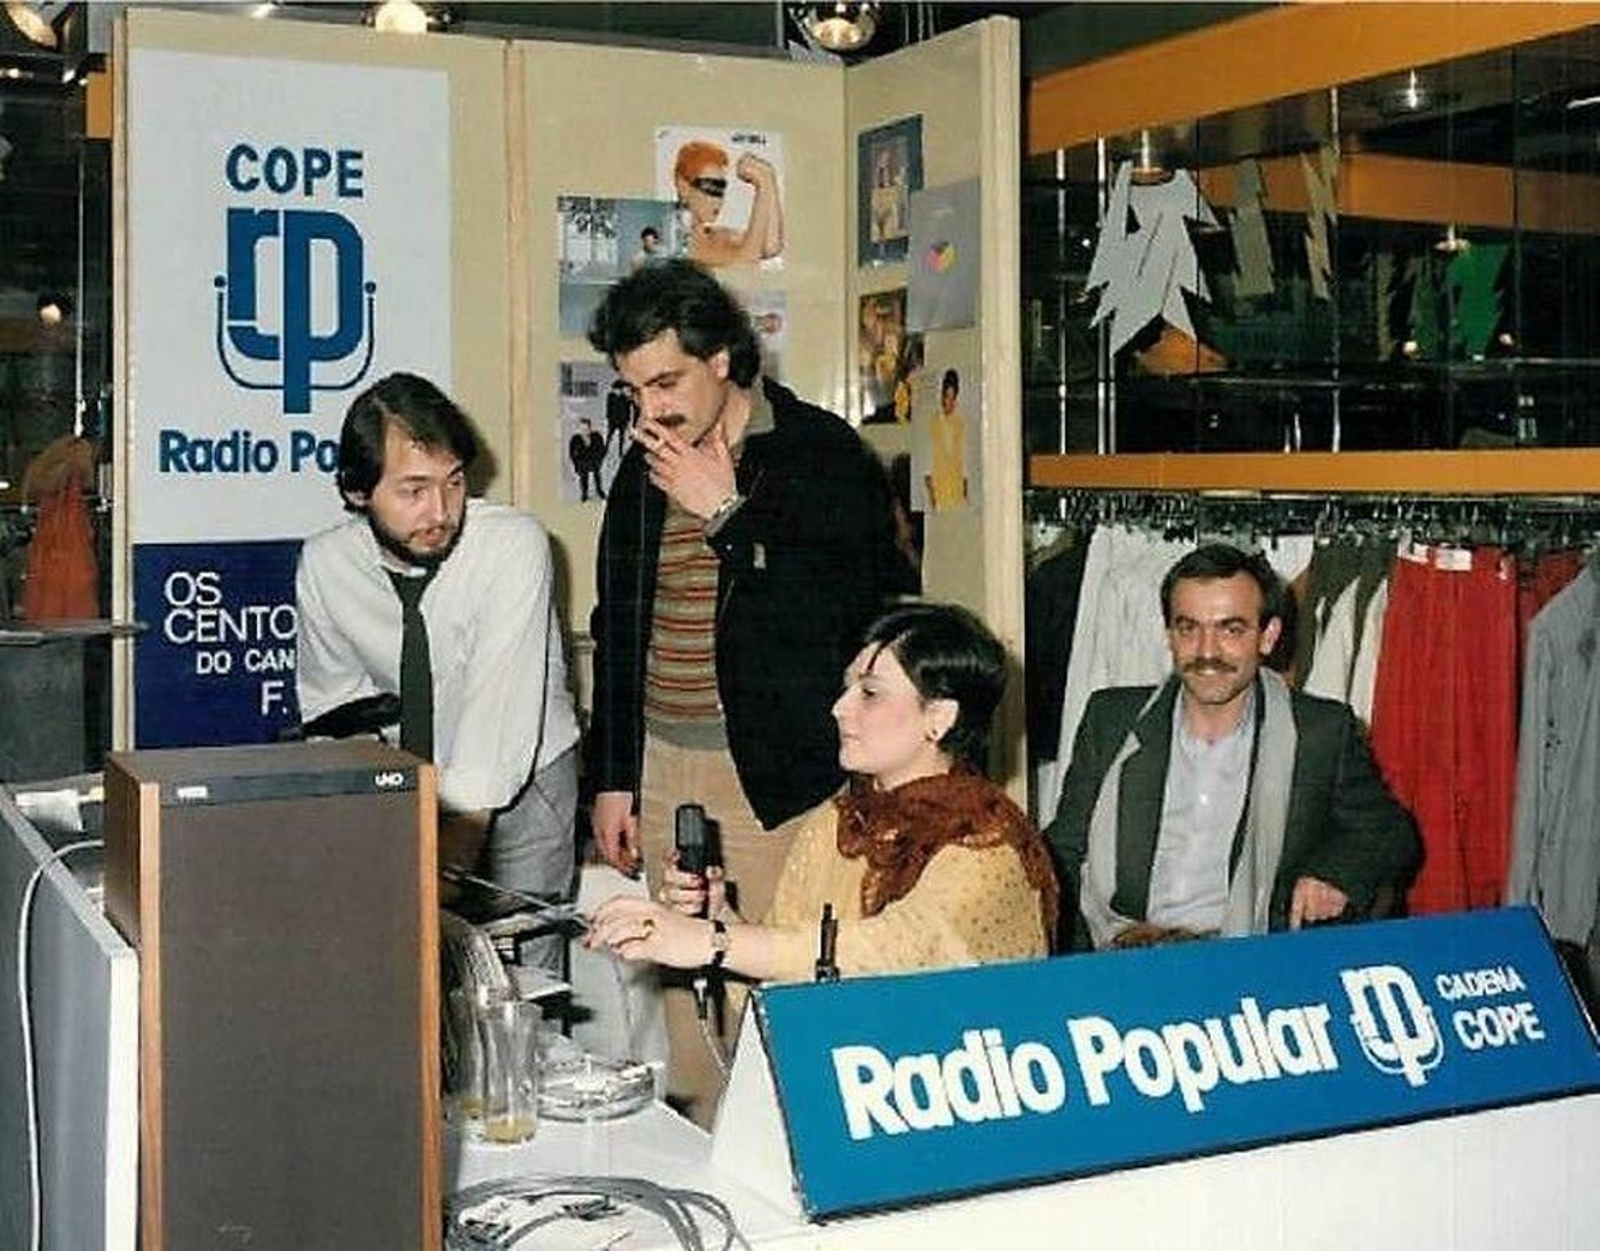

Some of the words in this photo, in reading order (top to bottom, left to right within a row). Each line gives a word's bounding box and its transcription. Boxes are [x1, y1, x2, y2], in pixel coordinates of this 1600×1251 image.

[226, 144, 363, 198] COPE
[159, 429, 279, 473] Radio
[164, 571, 222, 606] OS
[196, 651, 232, 675] DO
[1435, 965, 1527, 1001] CADENA
[1453, 1002, 1546, 1050] COPE
[832, 1028, 1067, 1140] Radio
[1067, 997, 1340, 1113] Popular
